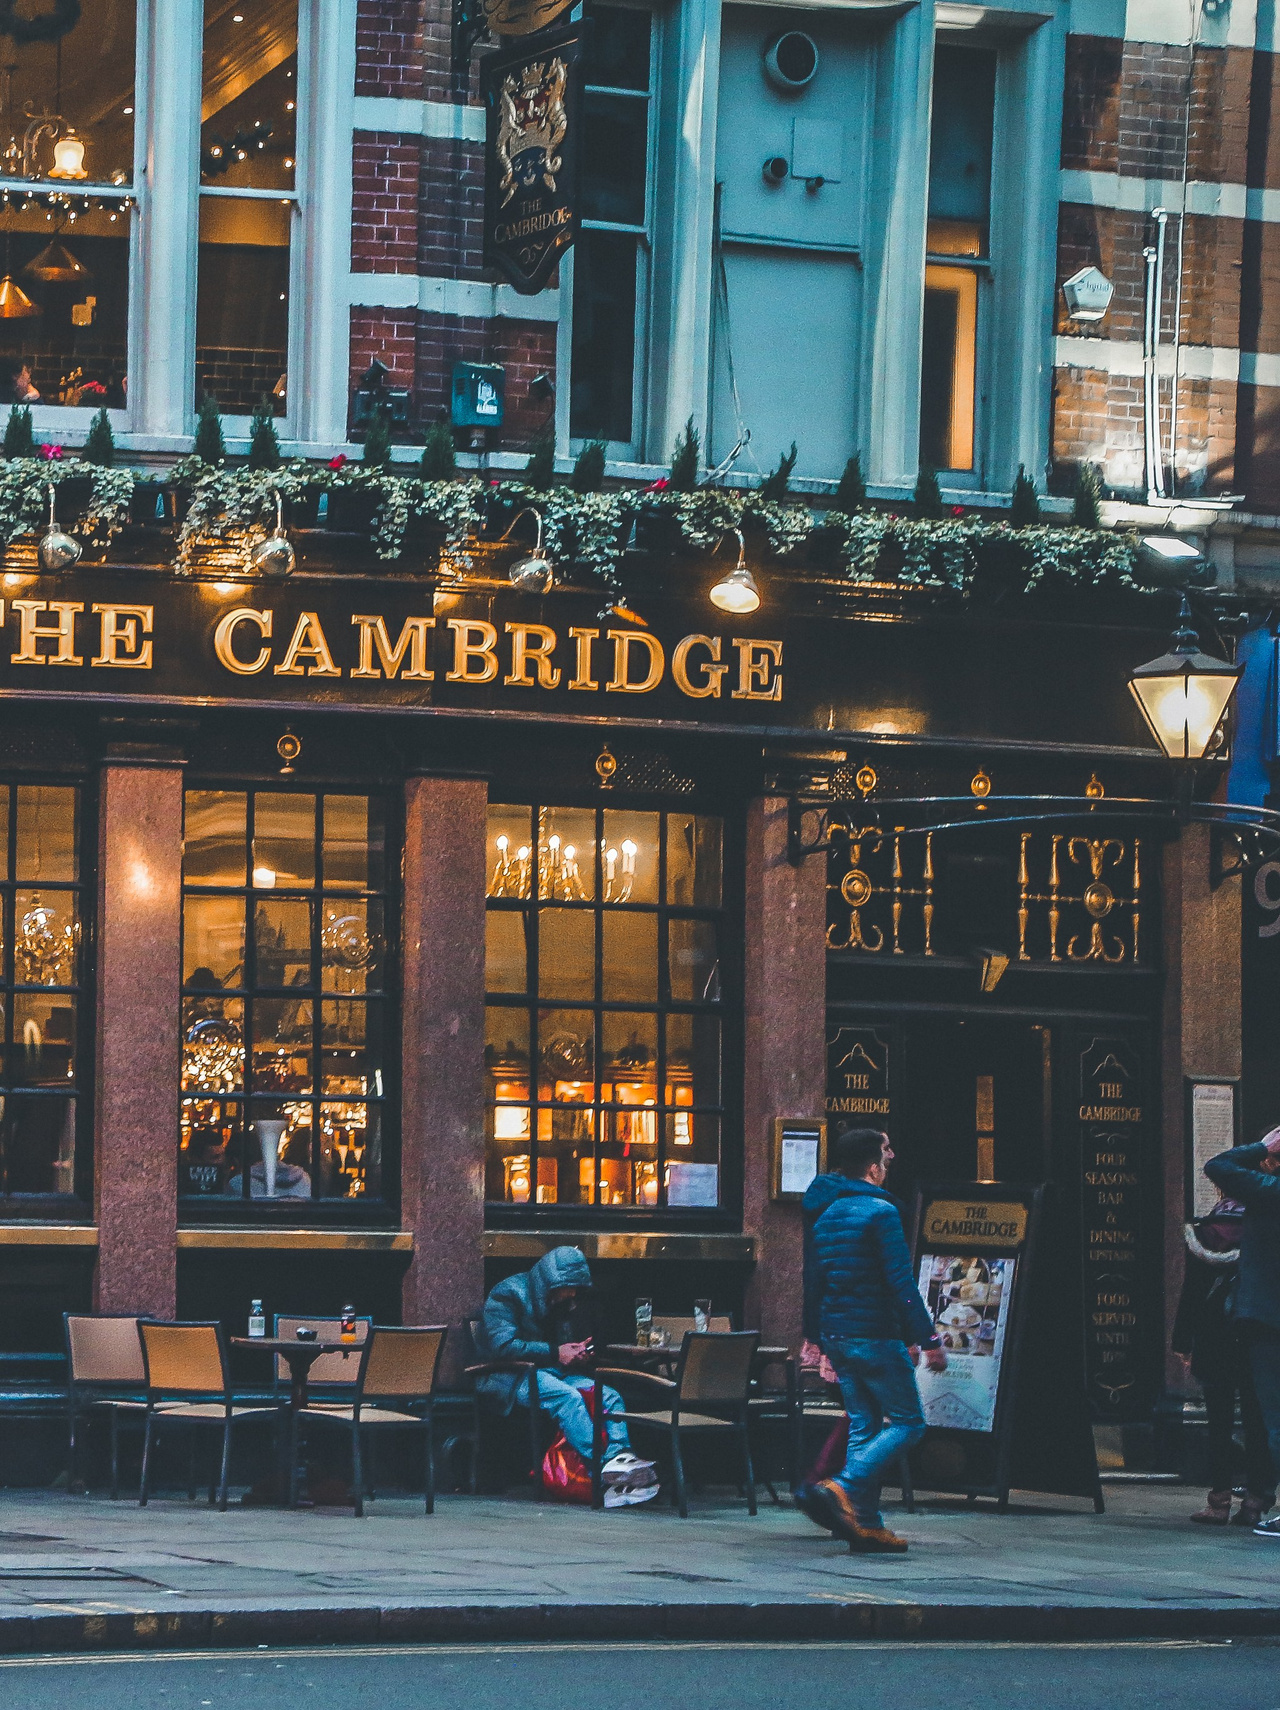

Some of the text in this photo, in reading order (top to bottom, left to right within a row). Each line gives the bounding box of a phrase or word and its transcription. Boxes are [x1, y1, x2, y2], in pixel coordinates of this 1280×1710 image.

[521, 198, 542, 216] THE
[214, 607, 784, 701] CAMBRIDGE
[844, 1073, 870, 1090] THE
[1099, 1083, 1123, 1099] THE
[825, 1096, 890, 1114] CAMBRIDGE
[1079, 1105, 1142, 1122] CAMBRIDGE
[1095, 1152, 1126, 1166] FOUR
[1084, 1171, 1137, 1186] SEASONS
[1098, 1191, 1124, 1205] BAR
[965, 1206, 988, 1219] THE
[1106, 1211, 1117, 1223] &
[931, 1219, 1018, 1238] CAMBRIDGE
[1089, 1229, 1135, 1244] DINING
[1096, 1293, 1130, 1307] FOOD
[1091, 1312, 1137, 1326] SERVED
